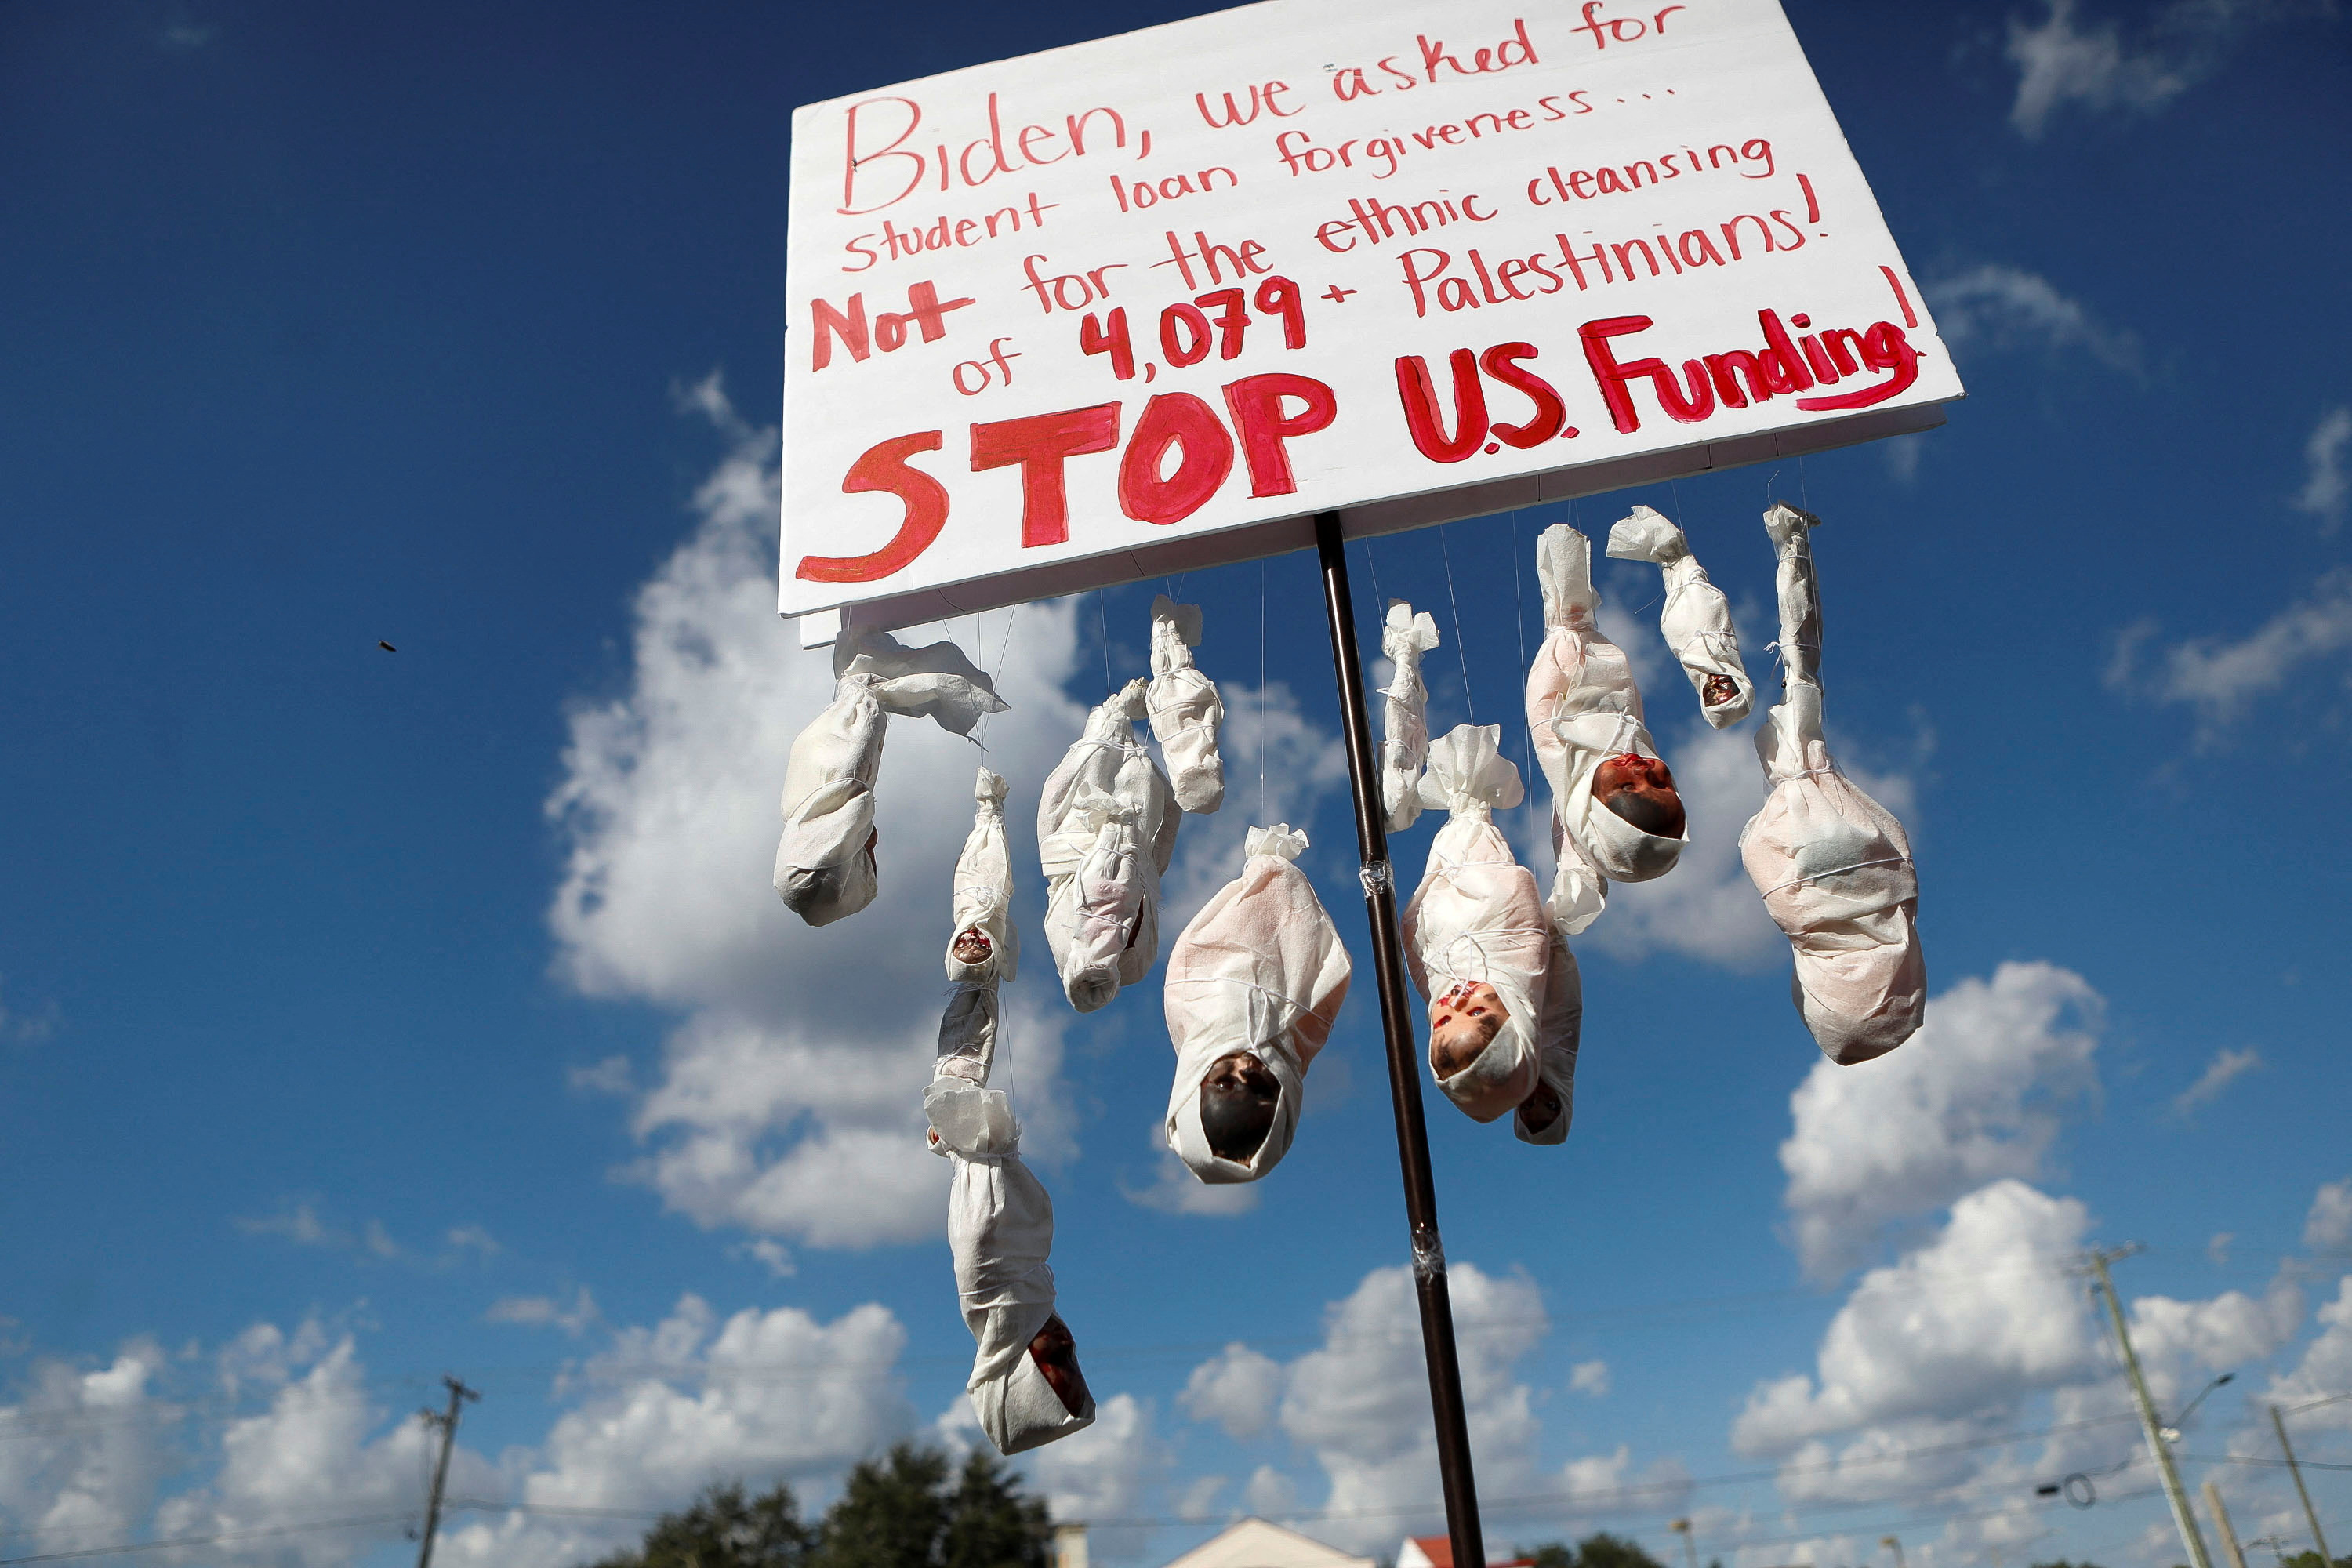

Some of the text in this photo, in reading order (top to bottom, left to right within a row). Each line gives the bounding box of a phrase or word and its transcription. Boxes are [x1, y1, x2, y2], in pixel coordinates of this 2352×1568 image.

[836, 2, 1686, 215] Biden, we asked for
[842, 192, 1060, 272] student
[1110, 165, 1237, 213] loan
[810, 138, 1775, 372] Not for the ethnic cleansing
[953, 337, 1022, 395] of
[1396, 172, 1828, 318] Palestinians!
[795, 265, 1927, 583] STOP U.S. Funding!
